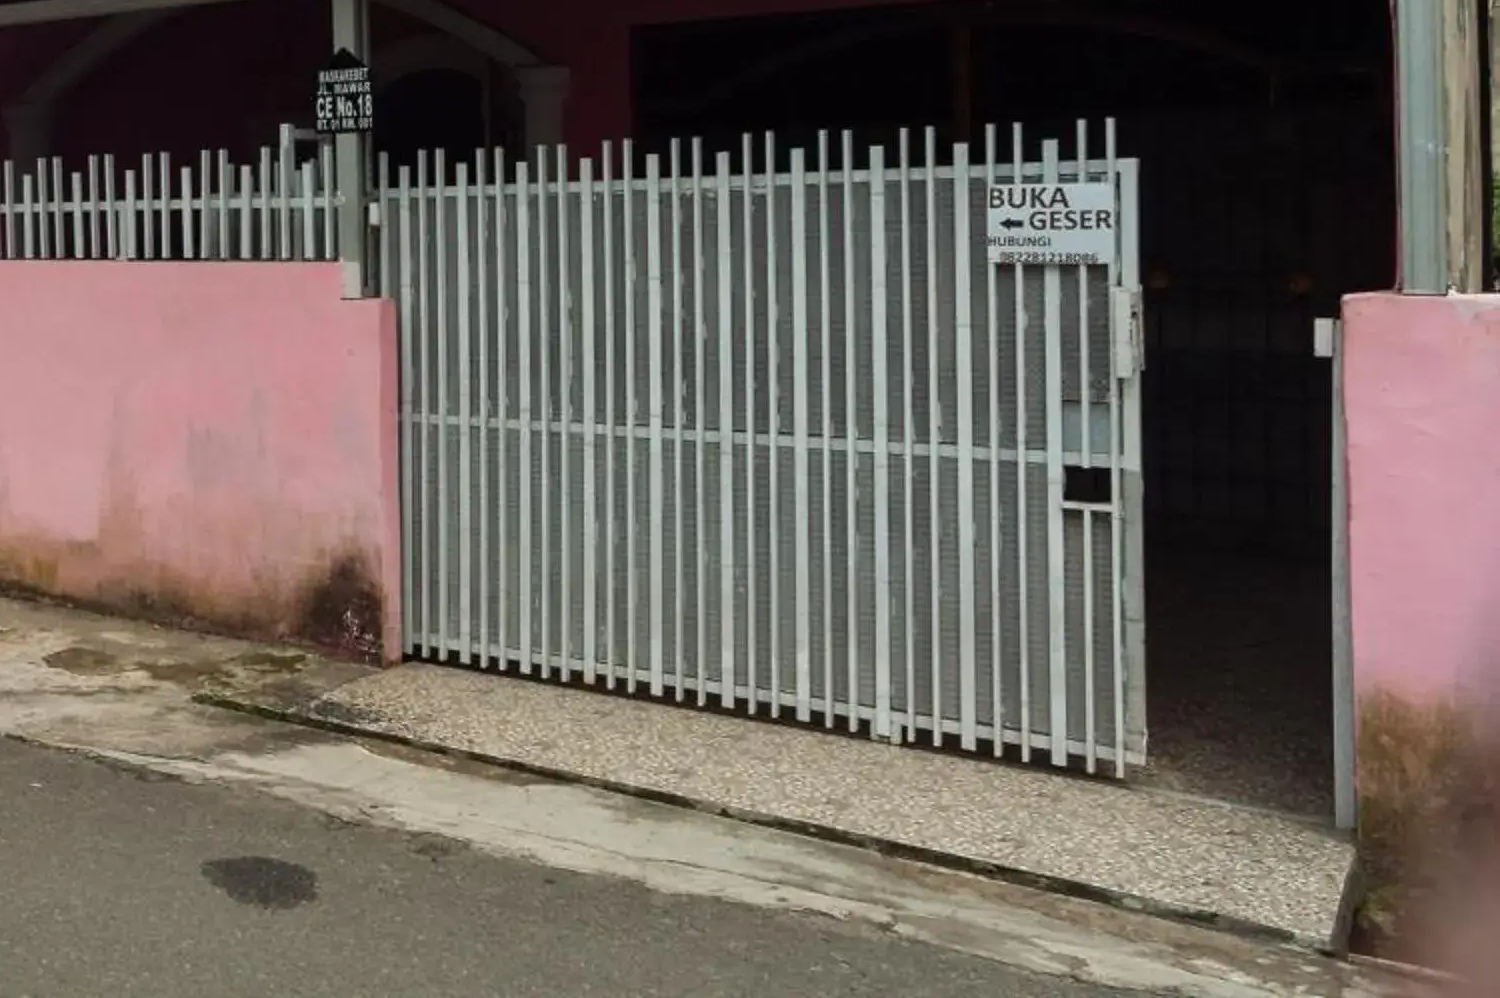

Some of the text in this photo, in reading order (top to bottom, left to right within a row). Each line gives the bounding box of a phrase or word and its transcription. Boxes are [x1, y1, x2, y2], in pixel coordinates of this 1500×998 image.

[334, 82, 371, 95] MAWAR
[316, 93, 373, 119] CE No.18
[989, 186, 1071, 210] BUKA
[1029, 209, 1113, 231] GESER
[987, 235, 1051, 248] HUBUNGI
